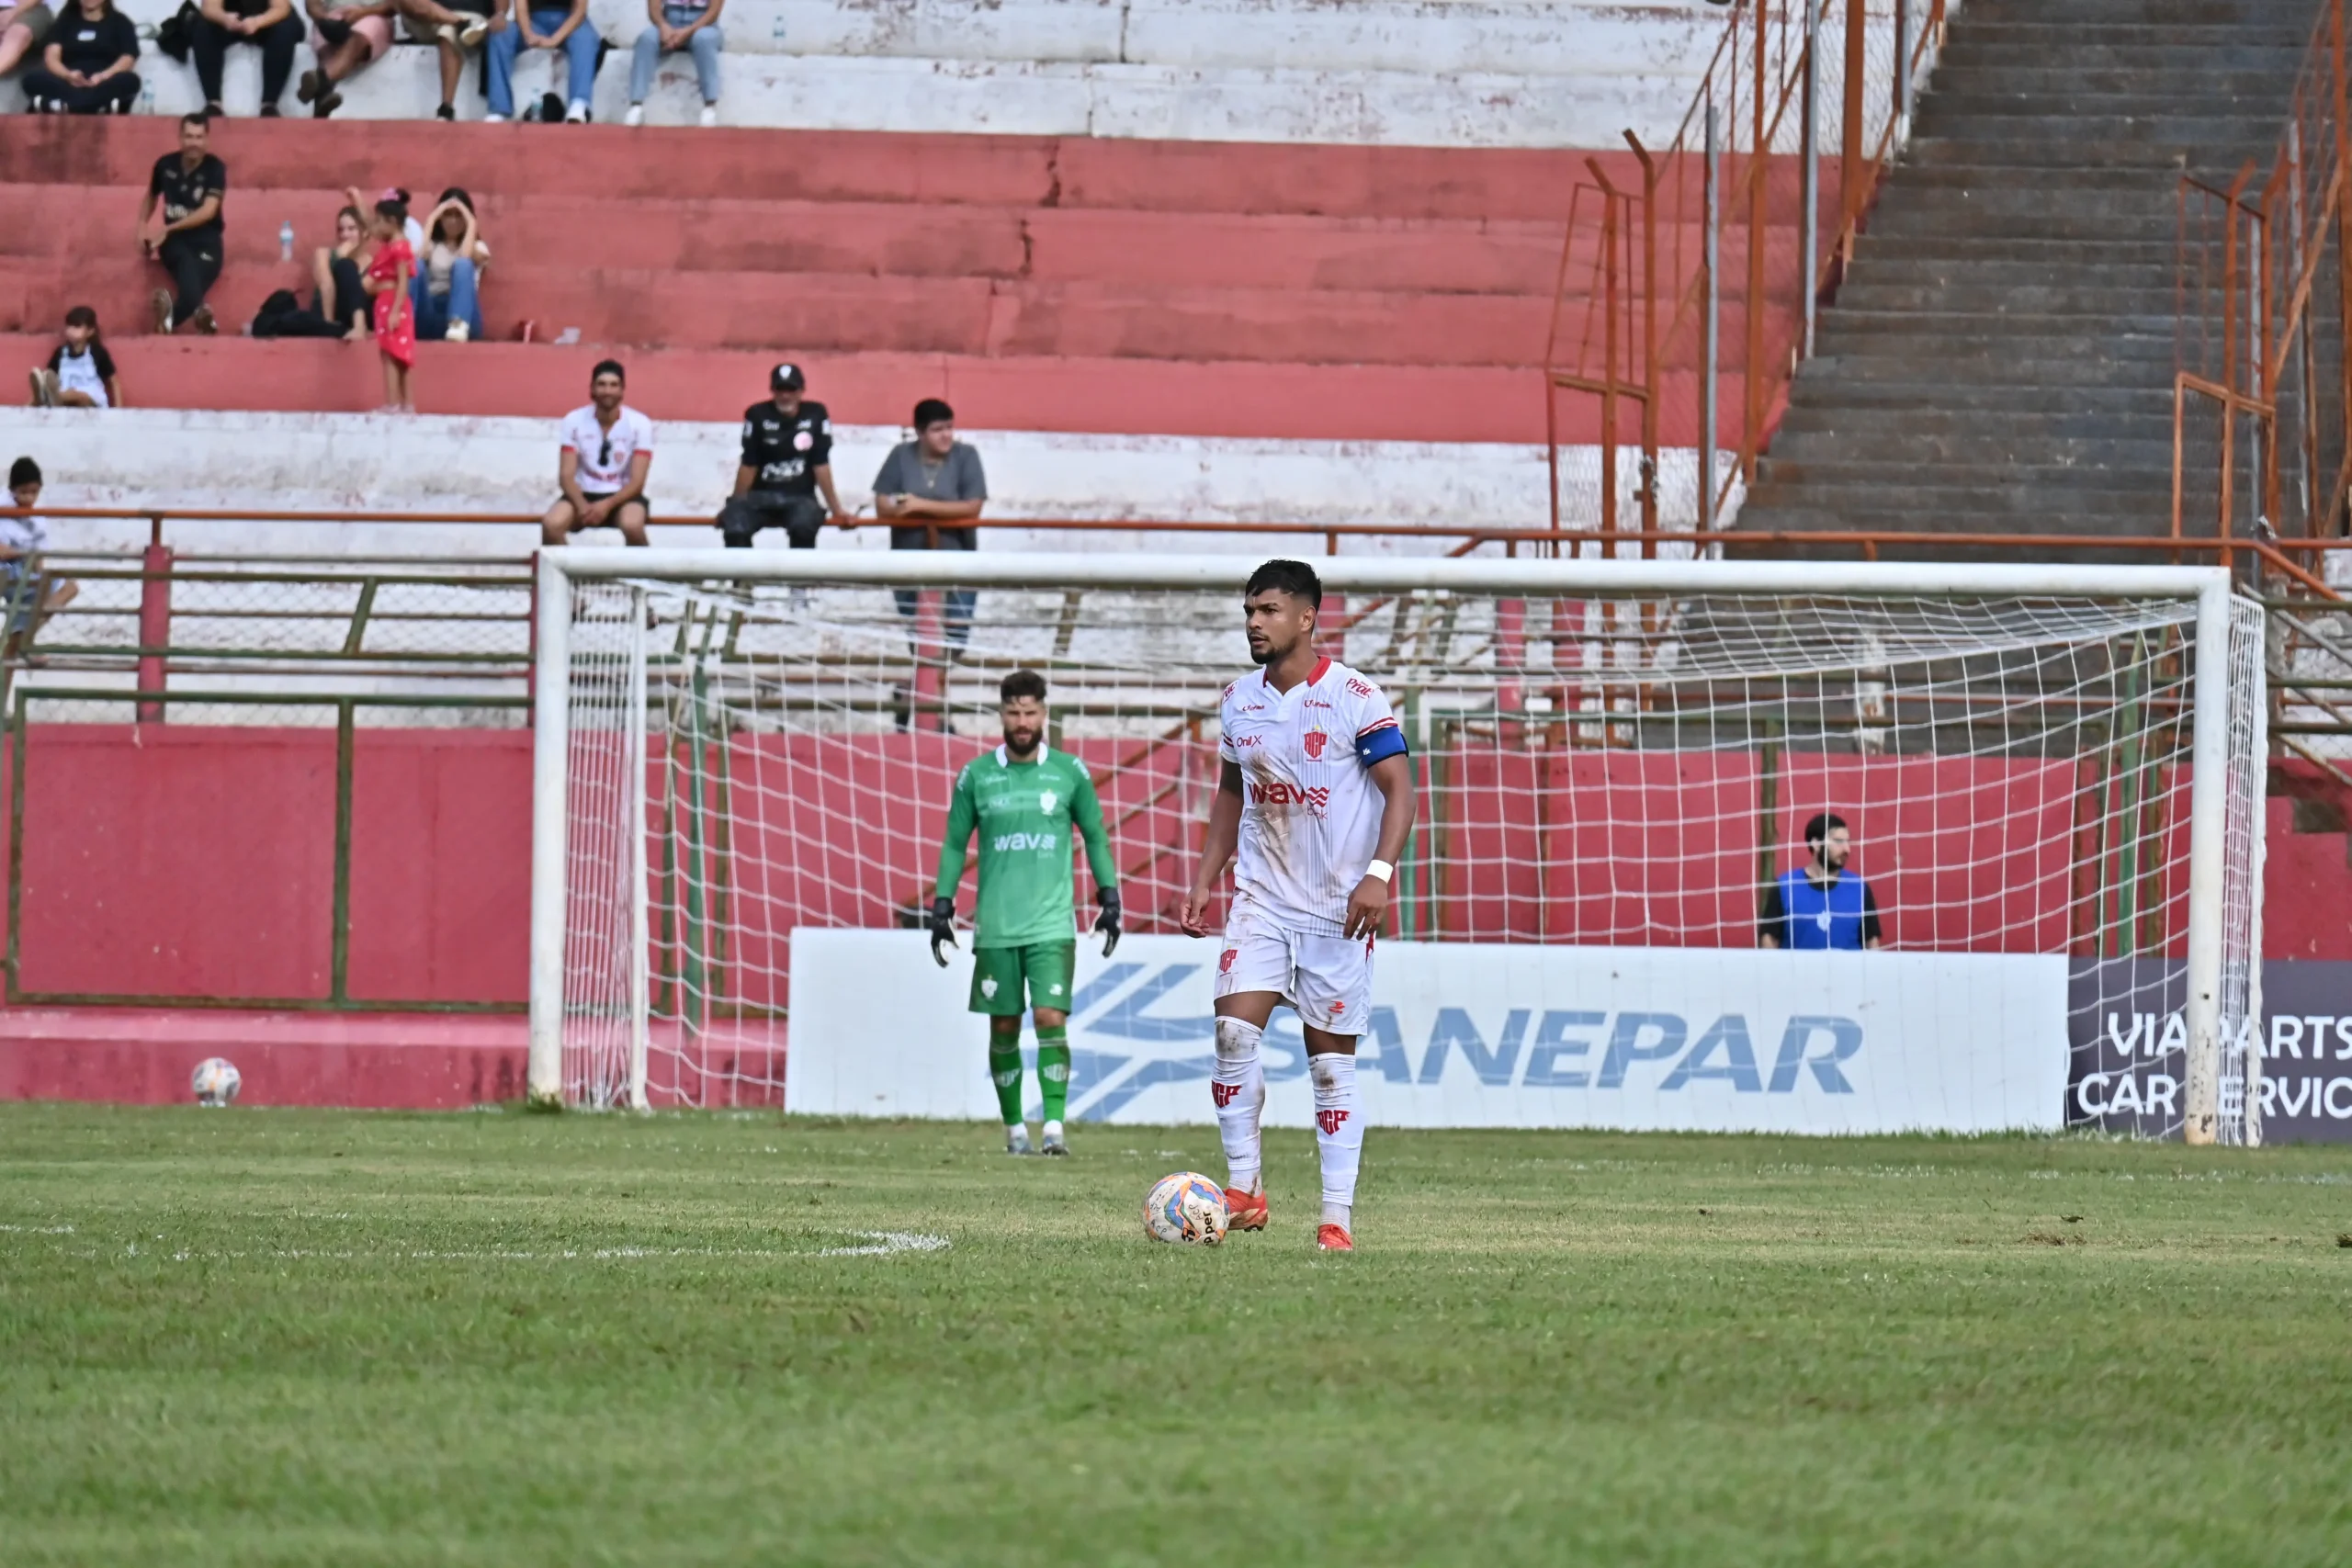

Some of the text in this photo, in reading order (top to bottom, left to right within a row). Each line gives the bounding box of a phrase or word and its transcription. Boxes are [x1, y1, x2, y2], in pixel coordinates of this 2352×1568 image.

[1307, 805, 1329, 819] bnk
[1261, 1006, 1862, 1093] SANEPAR
[2077, 1074, 2352, 1119] CAR ERVIC
